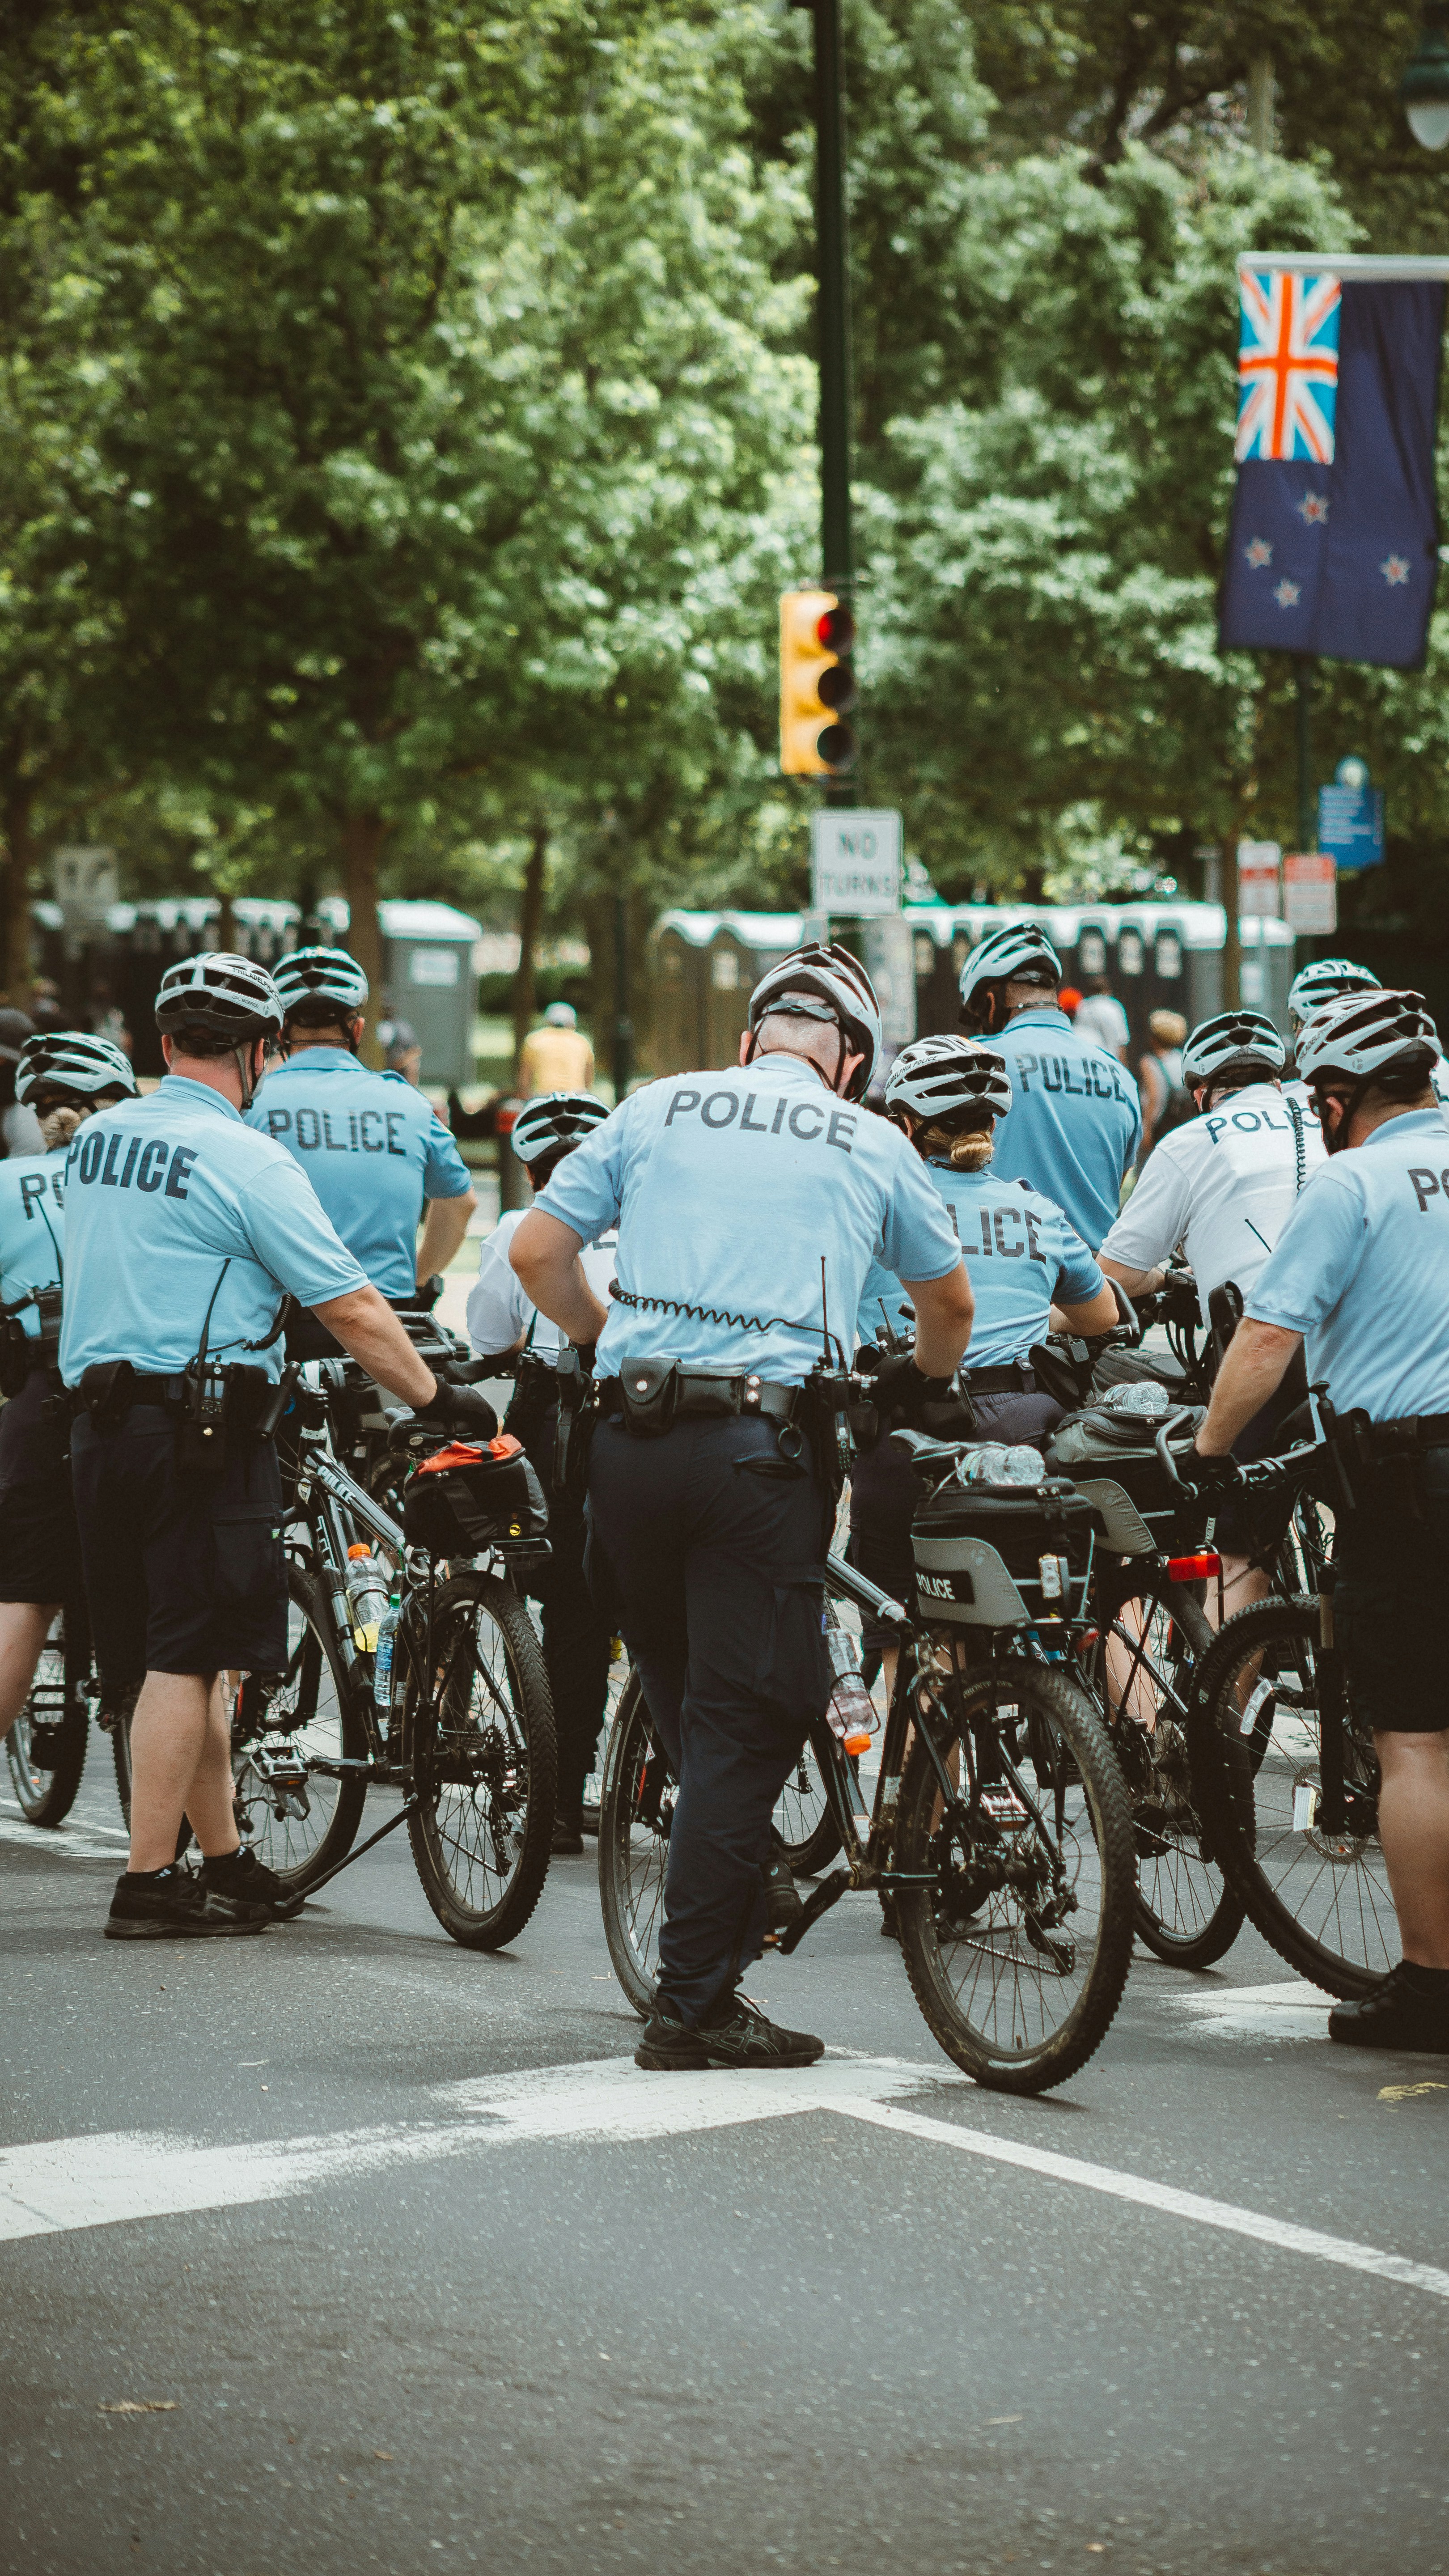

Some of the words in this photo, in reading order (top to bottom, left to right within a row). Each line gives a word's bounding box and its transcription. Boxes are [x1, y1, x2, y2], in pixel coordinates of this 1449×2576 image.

[837, 828, 877, 860] NO
[823, 872, 894, 898] TURNS
[913, 1055, 938, 1068] POLICE
[1016, 1053, 1127, 1103] POLICE
[268, 1109, 407, 1157] POLICE
[664, 1091, 858, 1155] POLICE
[65, 1131, 199, 1200] POLICE
[1407, 1168, 1449, 1212] P
[317, 1465, 356, 1504] POLICE
[916, 1572, 955, 1600] POLICE
